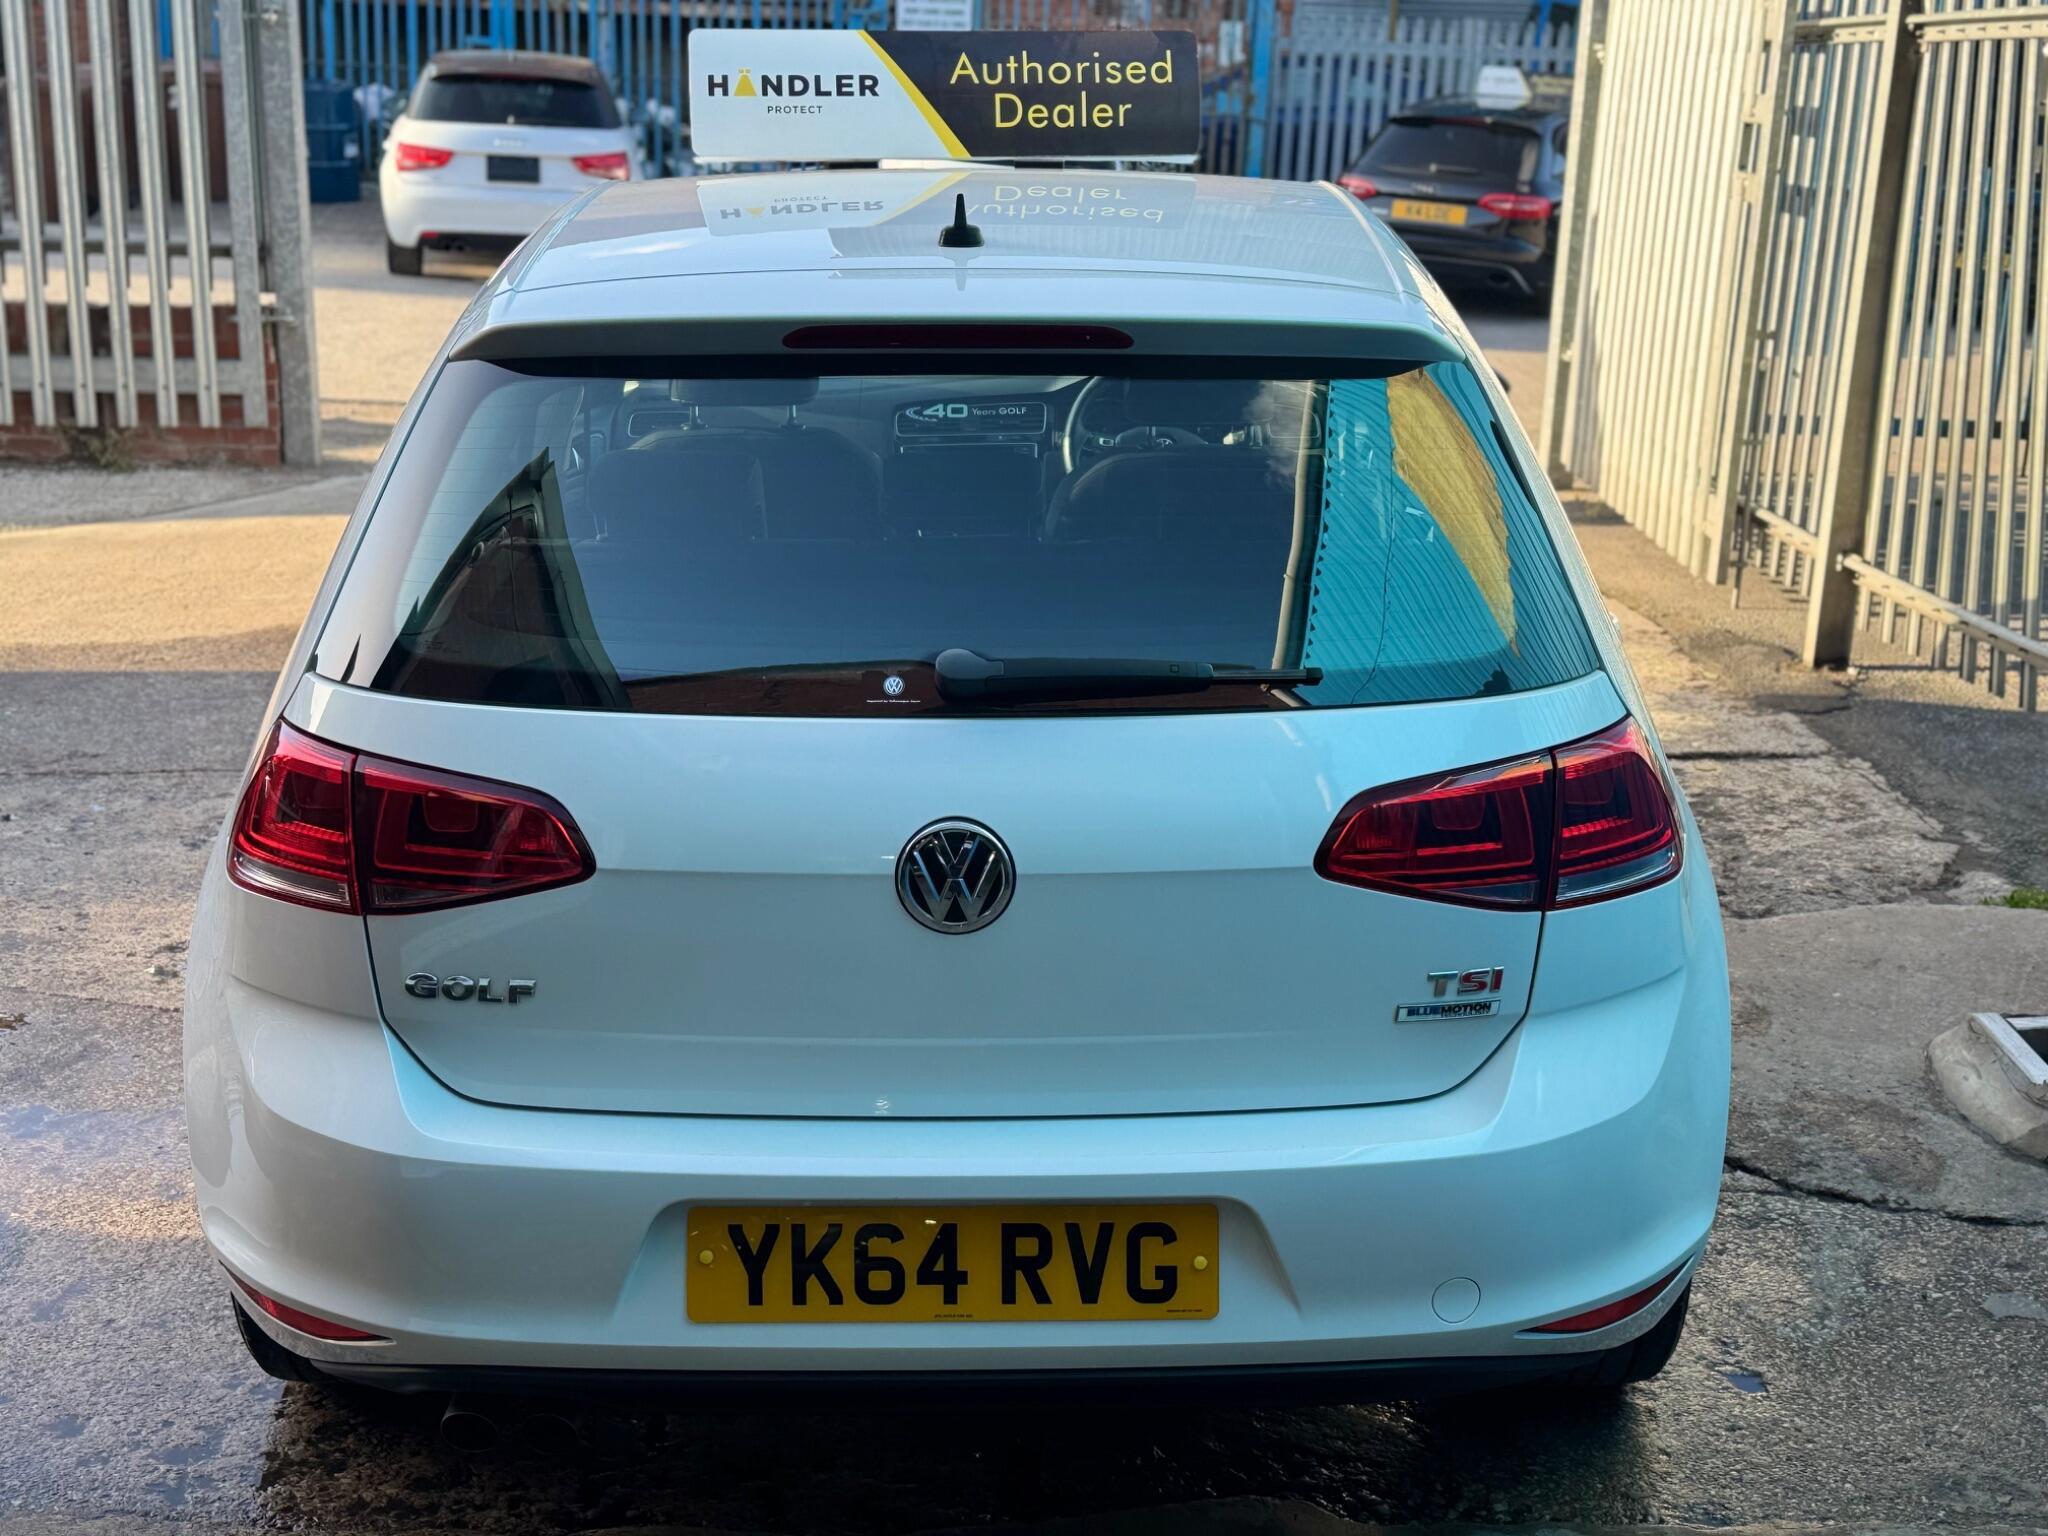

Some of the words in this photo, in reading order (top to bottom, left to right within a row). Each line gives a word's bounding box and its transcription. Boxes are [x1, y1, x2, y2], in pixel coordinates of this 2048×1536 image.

[950, 50, 1173, 85] Authorised
[767, 105, 823, 114] PROTECT
[994, 90, 1132, 128] Dealer
[922, 403, 968, 418] 40
[971, 407, 996, 416] Years
[998, 406, 1027, 416] GOLF
[404, 972, 537, 1004] GOLF
[1426, 965, 1505, 998] TSI
[1406, 1001, 1492, 1018] BLUEMOTION
[727, 1222, 969, 1306] YK64
[1000, 1221, 1178, 1305] RVG
